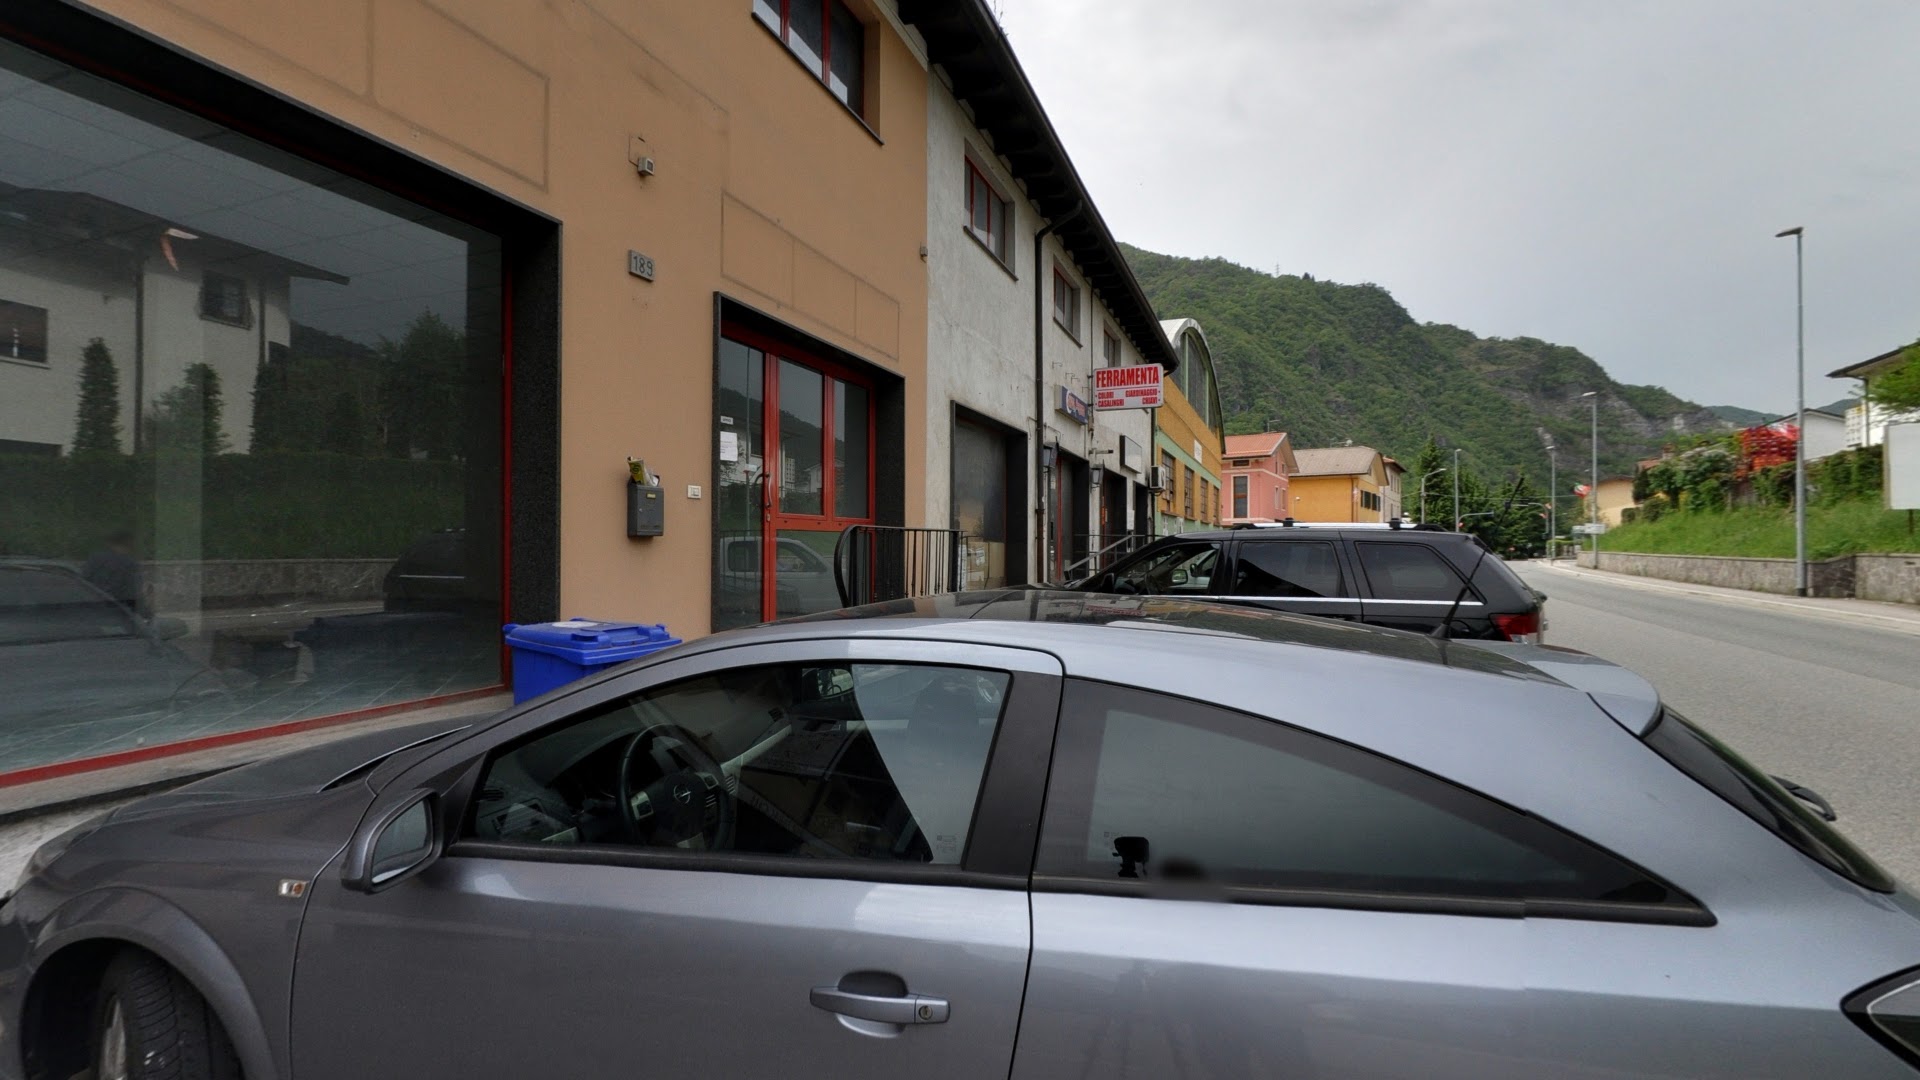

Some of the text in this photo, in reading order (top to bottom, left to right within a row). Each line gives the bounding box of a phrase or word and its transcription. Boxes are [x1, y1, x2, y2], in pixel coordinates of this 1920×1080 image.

[633, 255, 653, 277] 189
[1096, 367, 1159, 388] FERRAMENTA
[1098, 392, 1114, 400] COLORI
[1125, 388, 1158, 398] GIARDINAGGIO
[1098, 398, 1124, 408] CASALINGHI
[1142, 396, 1158, 405] CHIAVI
